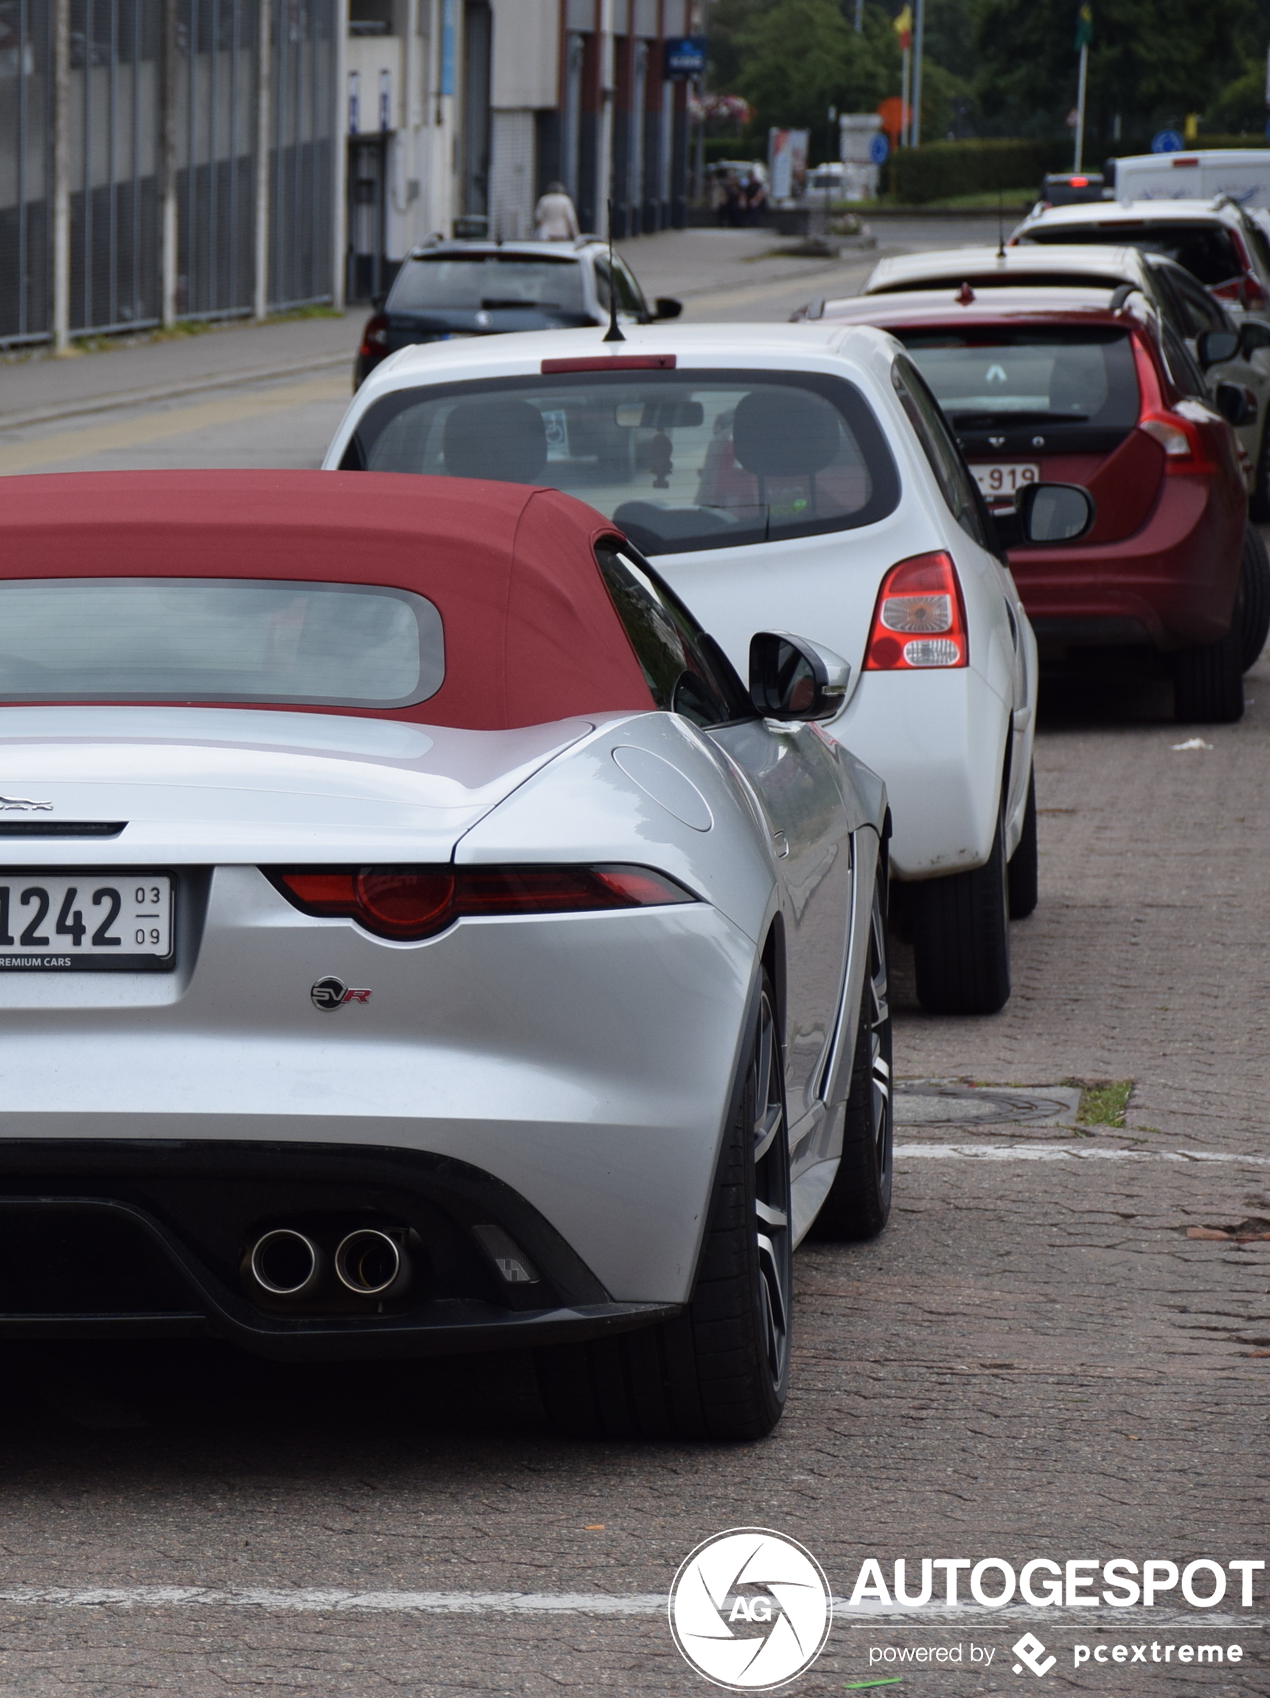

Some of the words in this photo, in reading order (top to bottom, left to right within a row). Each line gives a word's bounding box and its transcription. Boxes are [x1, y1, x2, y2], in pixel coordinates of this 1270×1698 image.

[135, 887, 161, 904] 03
[135, 928, 161, 945] 09
[43, 957, 72, 967] CARS
[312, 987, 372, 1004] SVR
